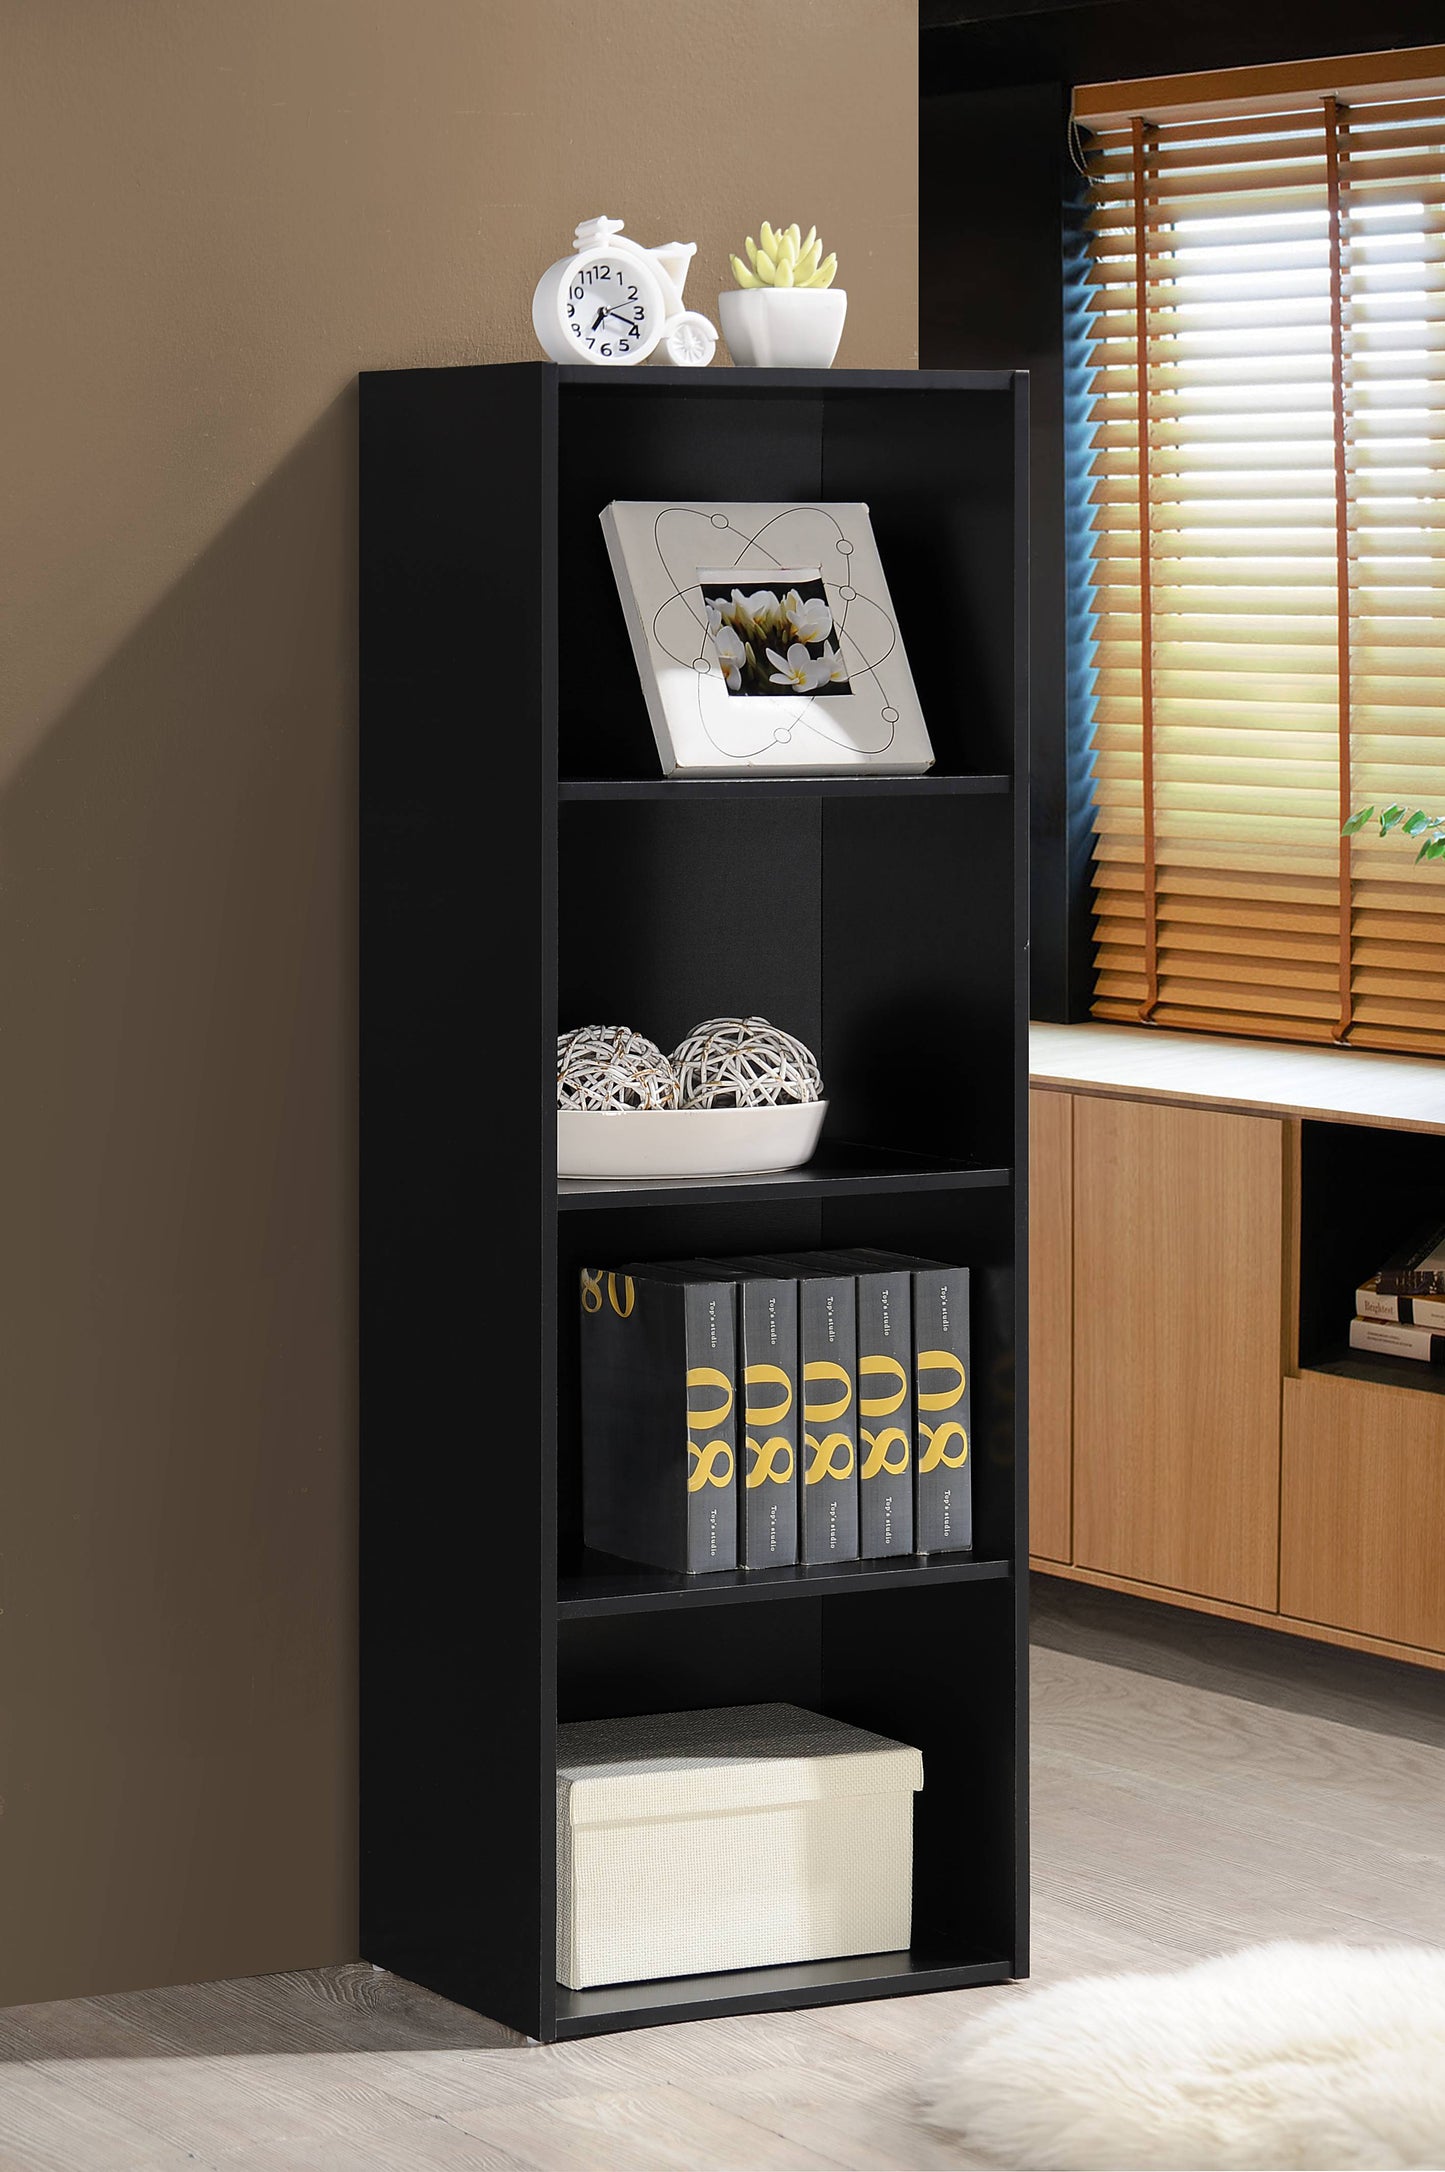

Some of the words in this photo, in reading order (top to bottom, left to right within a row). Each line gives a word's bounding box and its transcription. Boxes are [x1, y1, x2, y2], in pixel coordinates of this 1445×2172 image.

[578, 270, 592, 285] 11
[593, 265, 611, 280] 12
[616, 271, 623, 286] 1
[569, 285, 584, 300] 10
[627, 285, 638, 301] 2
[633, 305, 645, 321] 3
[628, 324, 641, 339] 4
[585, 338, 596, 350] 7
[600, 342, 613, 357] 6
[619, 339, 630, 352] 5
